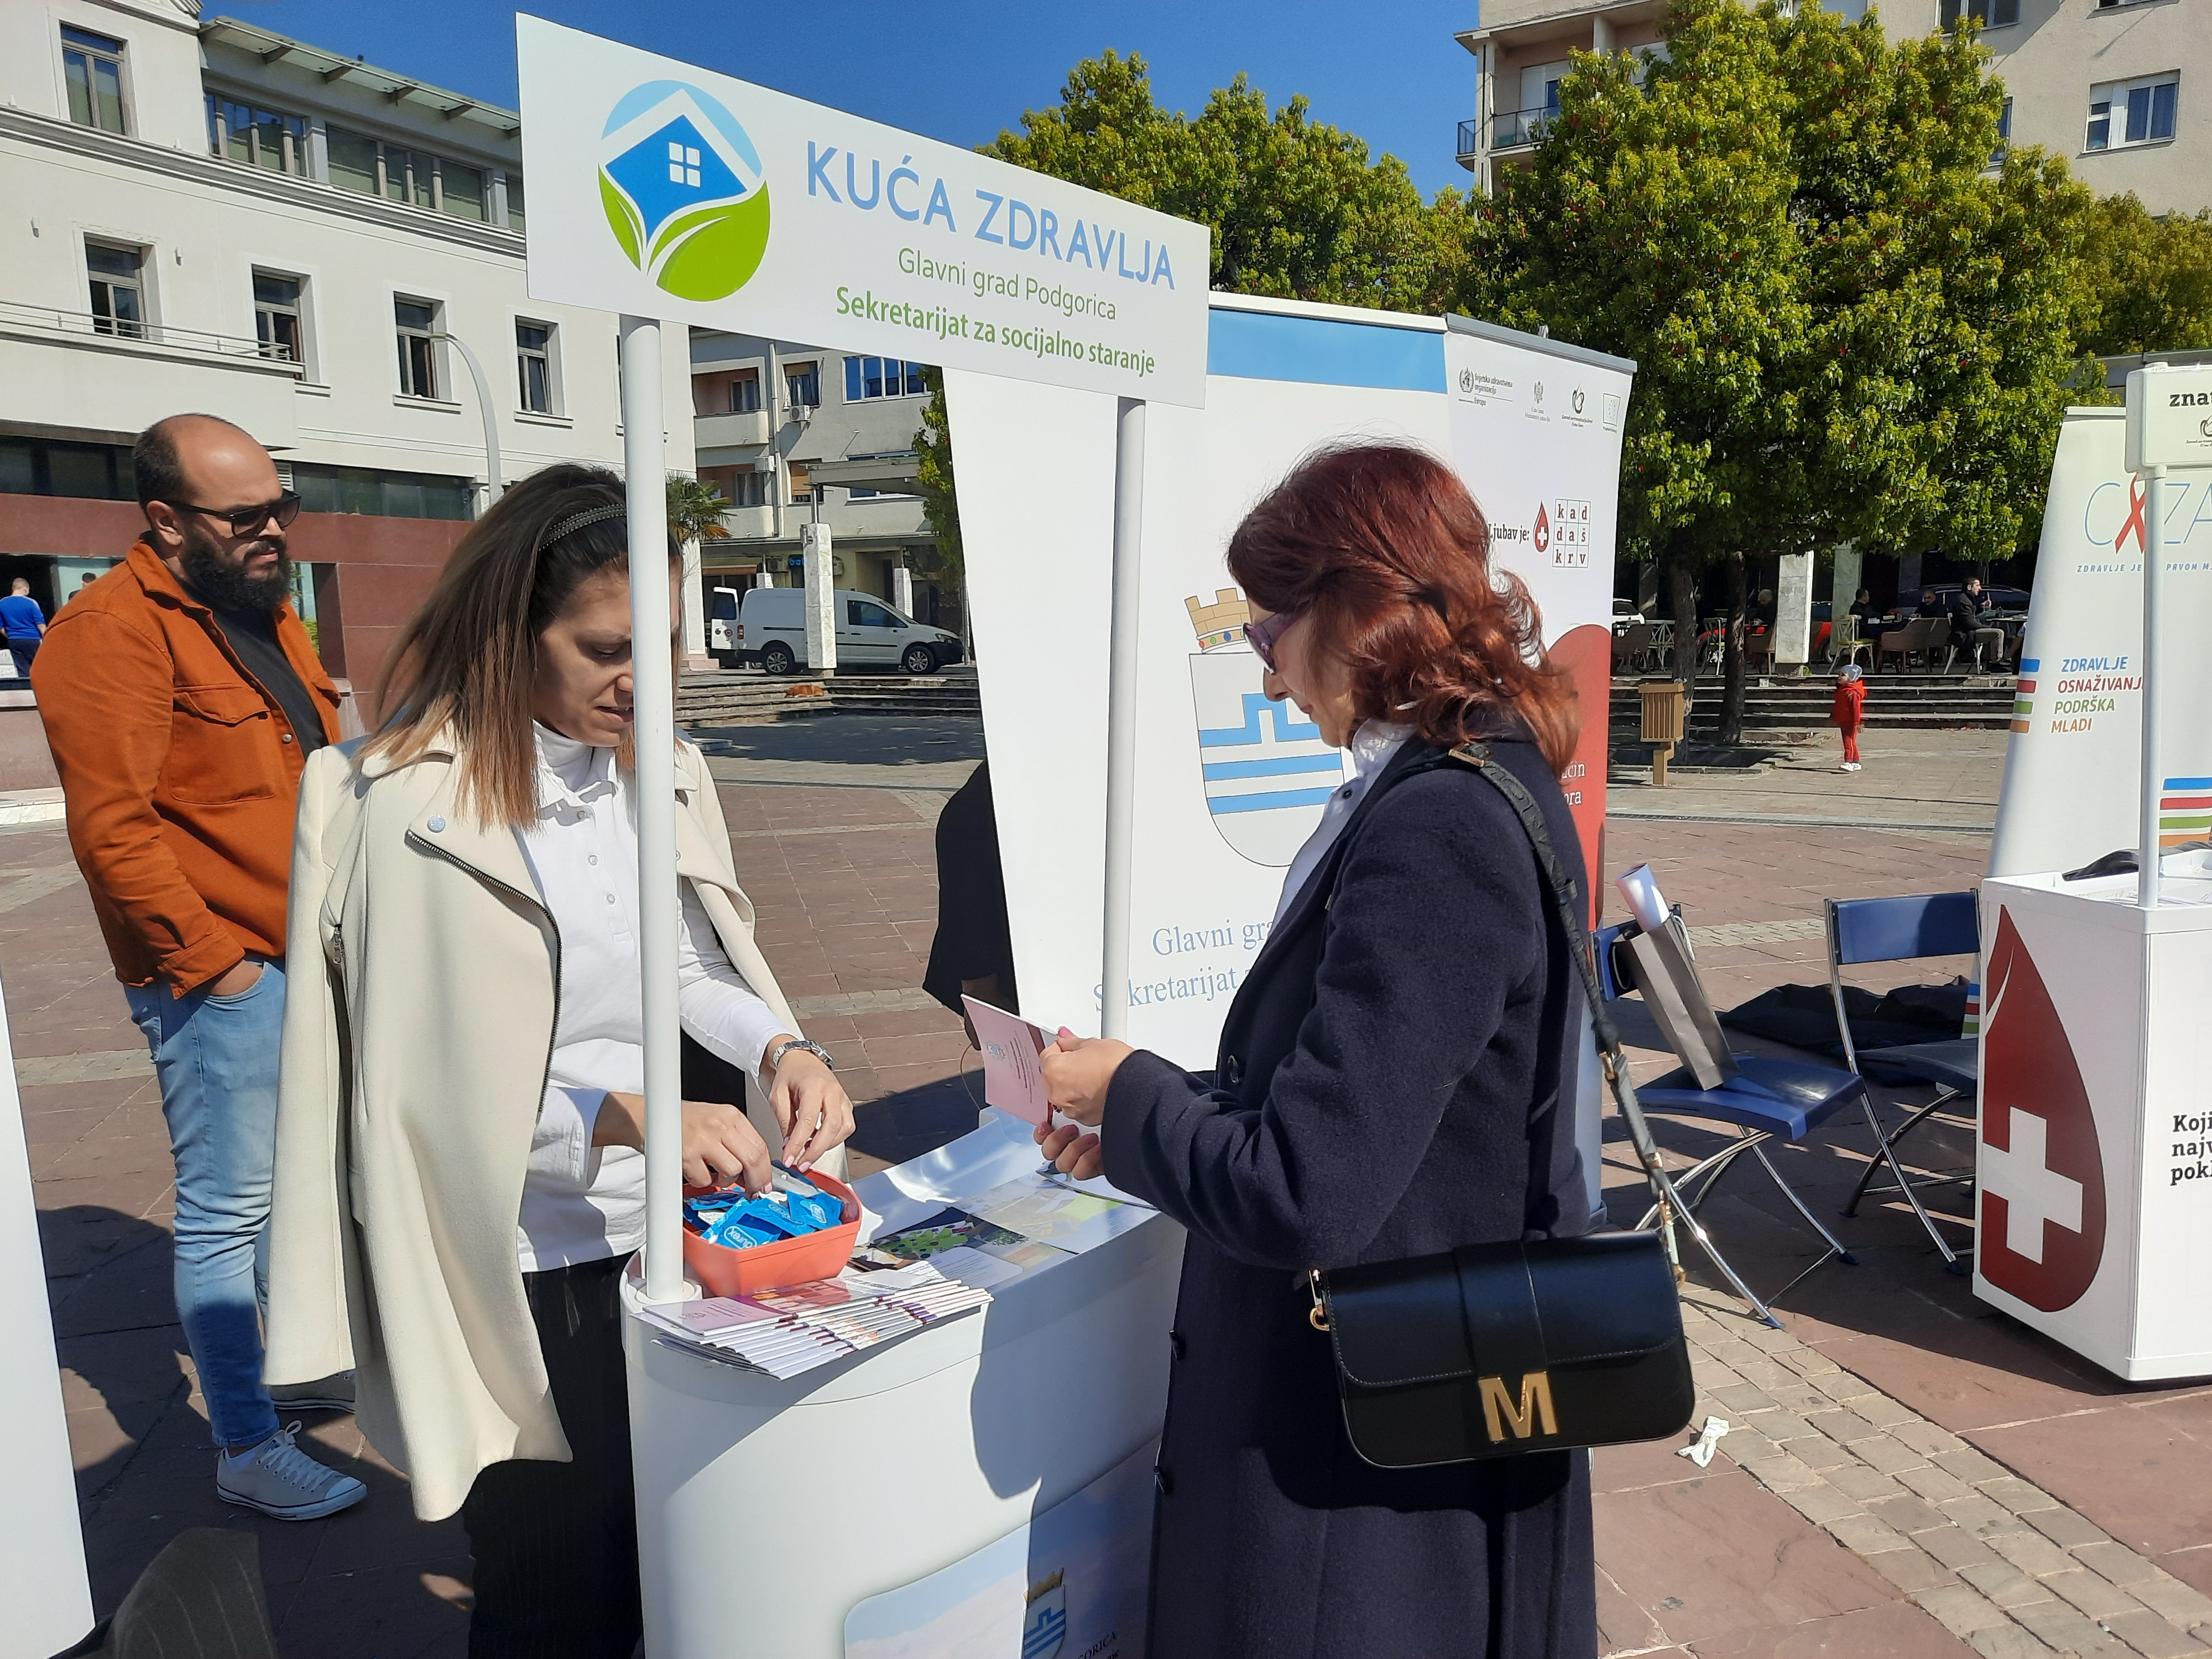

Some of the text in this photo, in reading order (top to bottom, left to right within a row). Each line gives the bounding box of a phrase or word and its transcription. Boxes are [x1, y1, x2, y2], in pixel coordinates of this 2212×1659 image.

[807, 140, 1175, 290] KUĆA ZDRAVLJA
[898, 247, 1117, 320] Glavni grad Podgorica
[836, 286, 1155, 378] Sekretarijat za socijalno staranje
[1488, 523, 1530, 545] Ljubav je:
[2077, 564, 2125, 573] ZDRAVLJE
[2130, 564, 2142, 572] JE
[2166, 562, 2198, 572] PRVOM
[2061, 656, 2128, 672] ZDRAVLJE
[2058, 674, 2143, 693] OSNAŽIVANJ
[2054, 695, 2115, 714] PODRŠKA
[2051, 718, 2093, 733] MLADI
[1152, 919, 1235, 956] Glavni
[1093, 966, 1238, 1012] Skretarijat
[727, 1227, 753, 1249] durex
[1478, 1370, 1559, 1444] M
